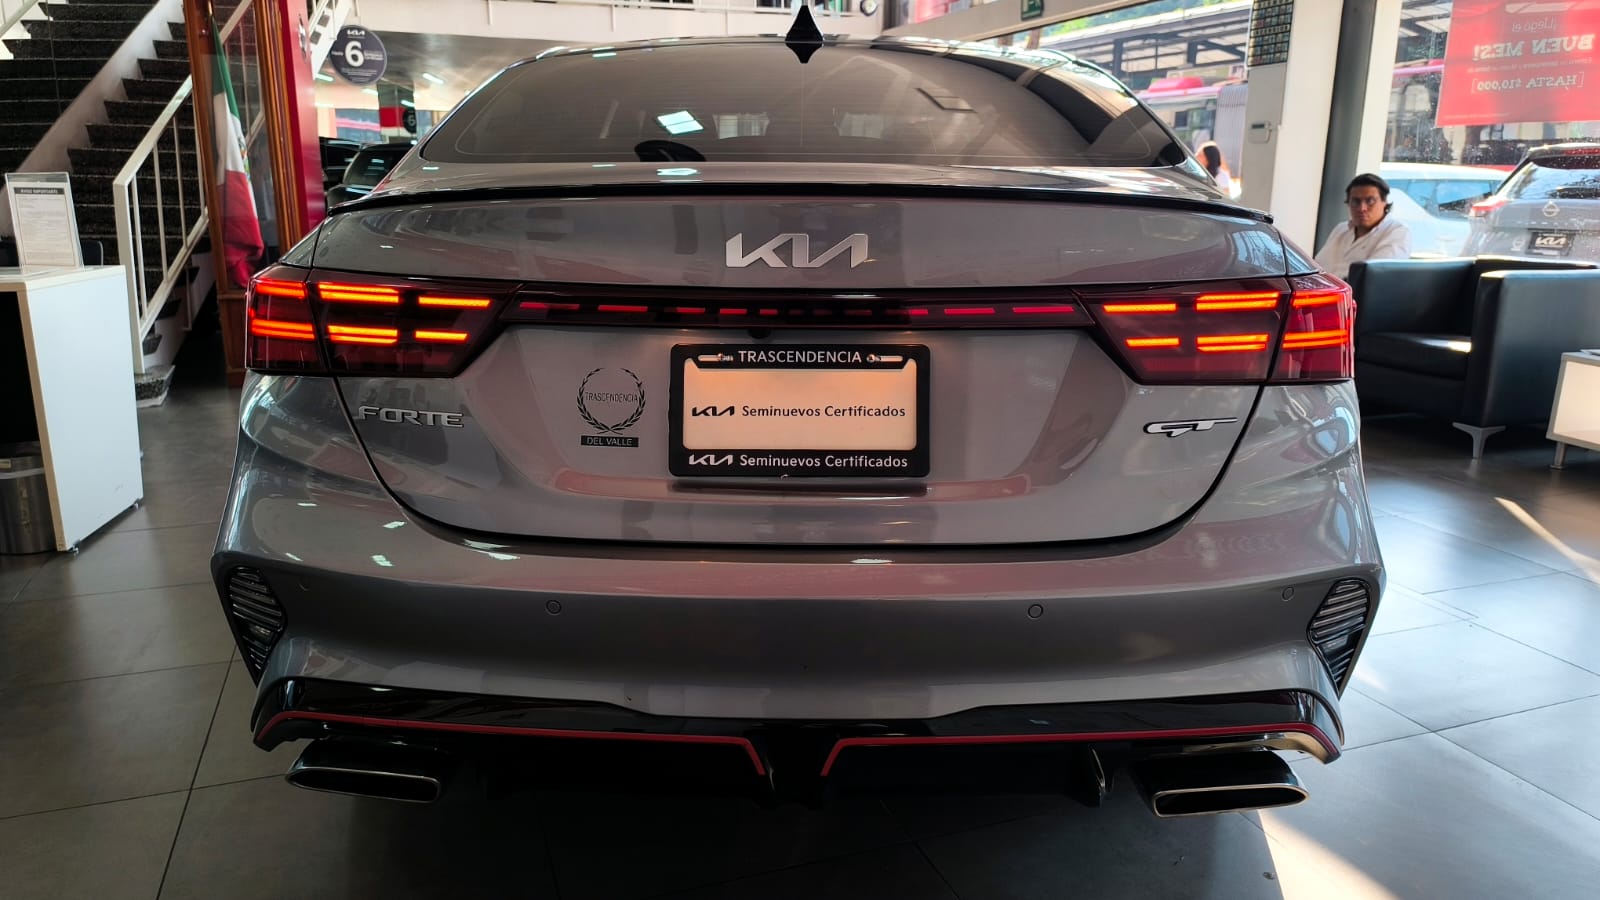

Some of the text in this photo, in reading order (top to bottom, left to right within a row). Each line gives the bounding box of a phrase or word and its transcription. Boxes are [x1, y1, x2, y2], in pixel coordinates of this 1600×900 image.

[345, 41, 364, 66] 6
[1535, 236, 1567, 245] KIA
[726, 233, 868, 269] KIA
[738, 351, 862, 363] TRASCENDENCIA
[585, 391, 638, 403] TRASCENDENCIA
[358, 405, 464, 428] FORTE
[692, 406, 906, 417] KIA Seminuevos Certificados
[1143, 417, 1238, 437] GT
[586, 437, 633, 446] DEL VALLE
[689, 454, 909, 468] KIA Seminuevos Certificados
